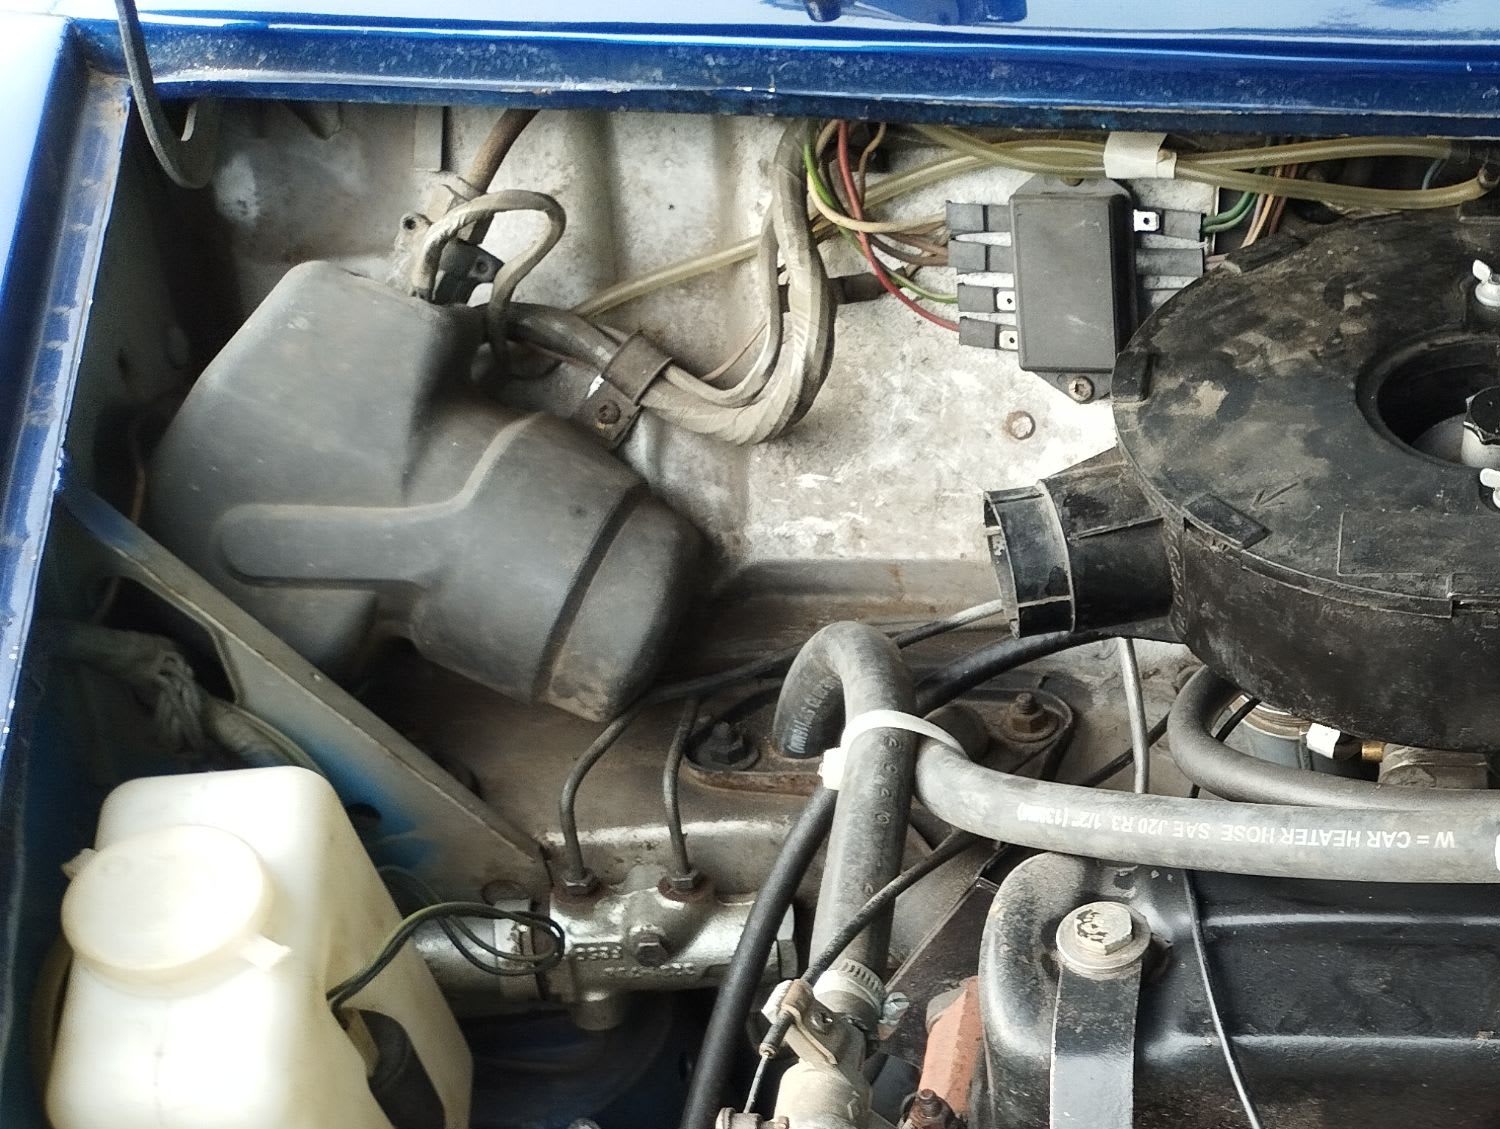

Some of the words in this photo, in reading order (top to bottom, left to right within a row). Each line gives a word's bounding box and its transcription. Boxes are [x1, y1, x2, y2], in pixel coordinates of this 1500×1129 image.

[1137, 817, 1166, 836] J20
[1172, 820, 1211, 841] SAE
[1220, 823, 1274, 844] HOSE
[1281, 827, 1361, 848] HEATER
[1366, 830, 1412, 849] CAR
[1433, 831, 1456, 849] W
